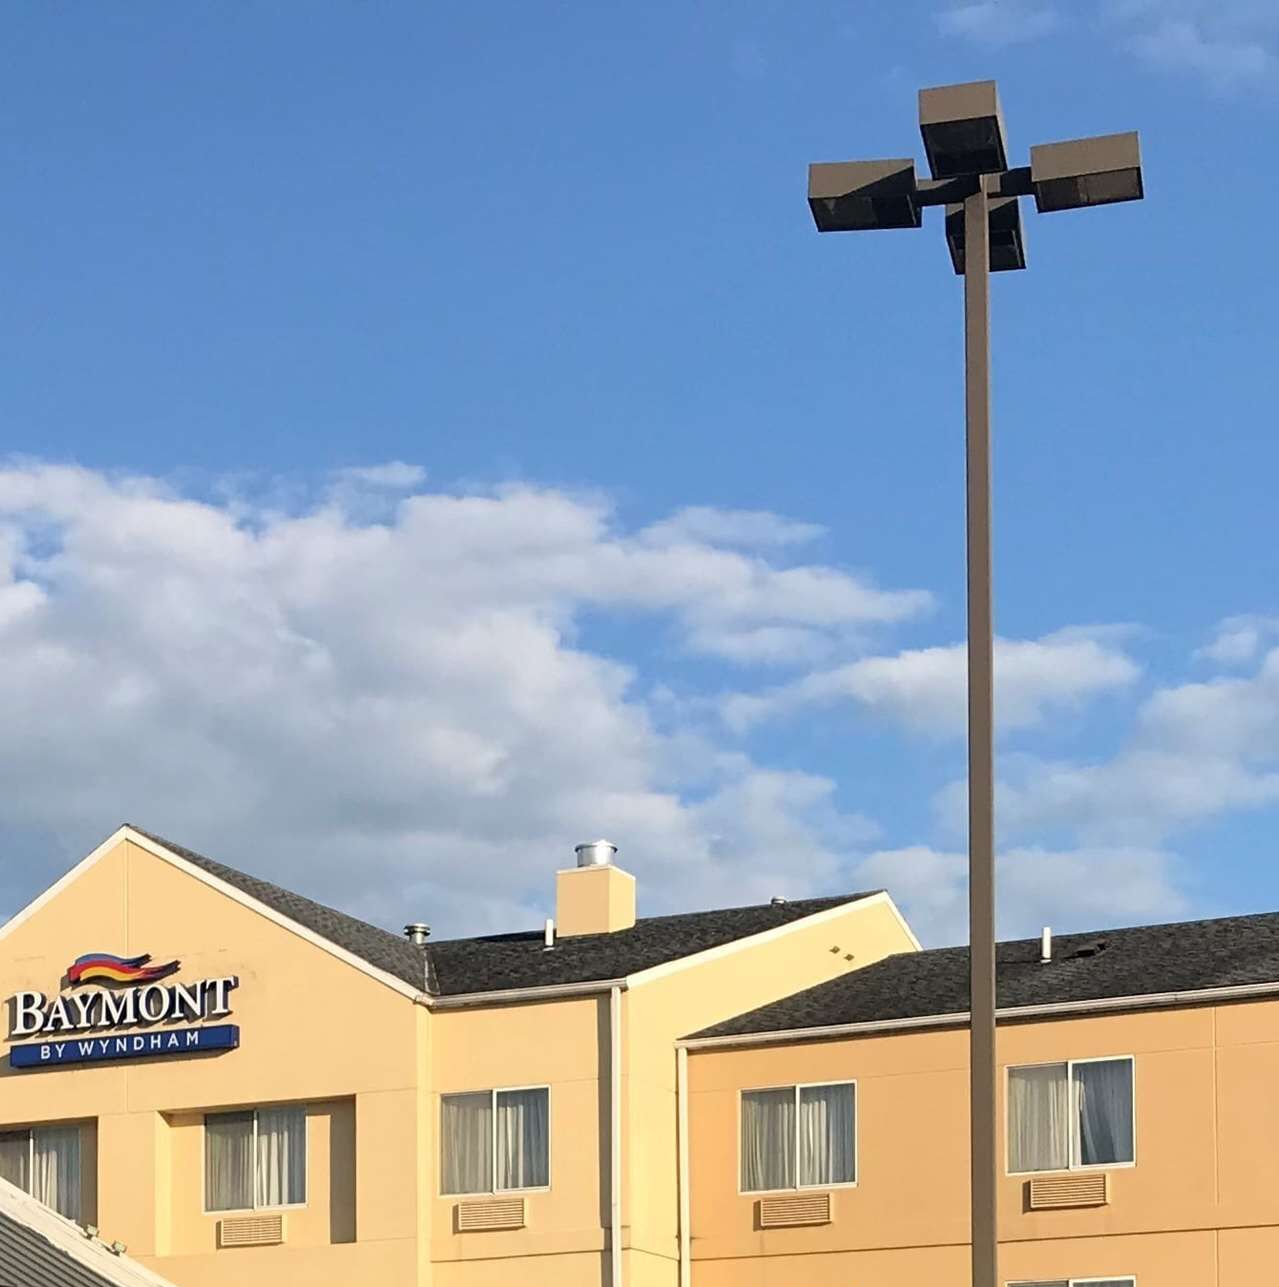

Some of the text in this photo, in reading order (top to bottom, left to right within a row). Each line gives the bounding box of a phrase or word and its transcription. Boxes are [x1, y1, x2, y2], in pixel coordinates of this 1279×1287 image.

[10, 975, 236, 1036] BAYMONT
[40, 1030, 200, 1060] BY WYNDHAM
